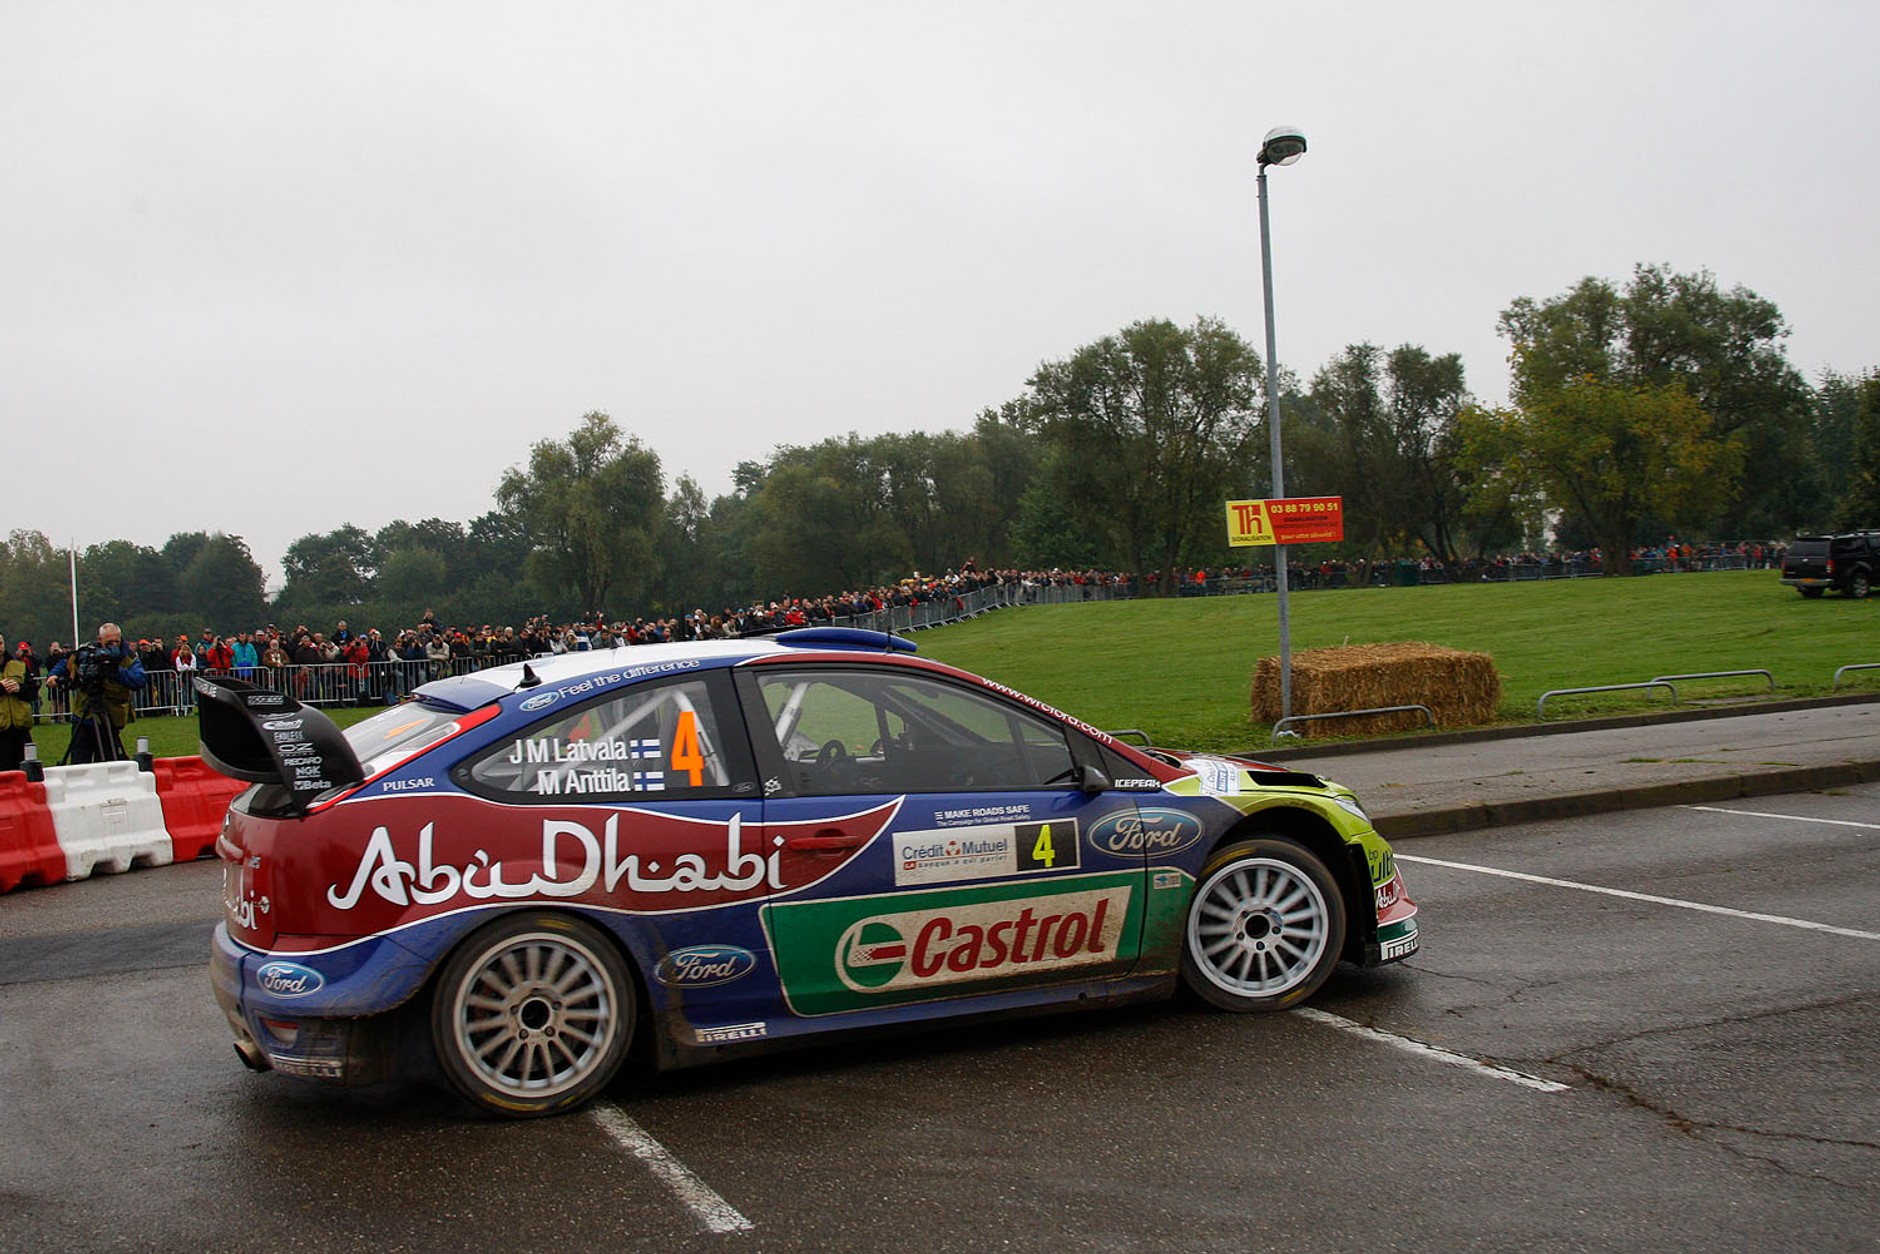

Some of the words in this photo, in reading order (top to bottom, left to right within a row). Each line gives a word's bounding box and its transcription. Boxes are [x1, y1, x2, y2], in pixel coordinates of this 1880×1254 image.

[1271, 505, 1282, 513] 03
[1327, 502, 1338, 511] 51
[1231, 504, 1263, 535] Th
[559, 680, 594, 698] Feel
[594, 674, 622, 687] the
[624, 658, 700, 680] difference
[279, 742, 314, 753] OZ
[509, 739, 524, 765] J
[527, 739, 551, 764] M
[553, 737, 629, 763] Latvala
[671, 711, 705, 787] 4
[284, 757, 322, 767] RECARO
[296, 766, 321, 776] NGK
[304, 780, 332, 790] Beta
[383, 776, 435, 792] PULSAR
[537, 769, 561, 796] M
[565, 767, 631, 795] Anttila
[1114, 779, 1161, 789] ICEPEAK
[944, 809, 971, 820] MAKE
[972, 806, 1004, 818] ROADS
[1006, 804, 1031, 815] SAFE
[1109, 816, 1182, 852] Ford
[902, 844, 944, 861] Crédit
[962, 839, 1008, 855] Mutuel
[1032, 824, 1056, 868] 4
[1369, 850, 1379, 862] bp
[911, 899, 1110, 979] Castrol
[675, 951, 738, 980] Ford
[264, 965, 306, 993] Ford
[695, 1022, 768, 1042] PIRELLI
